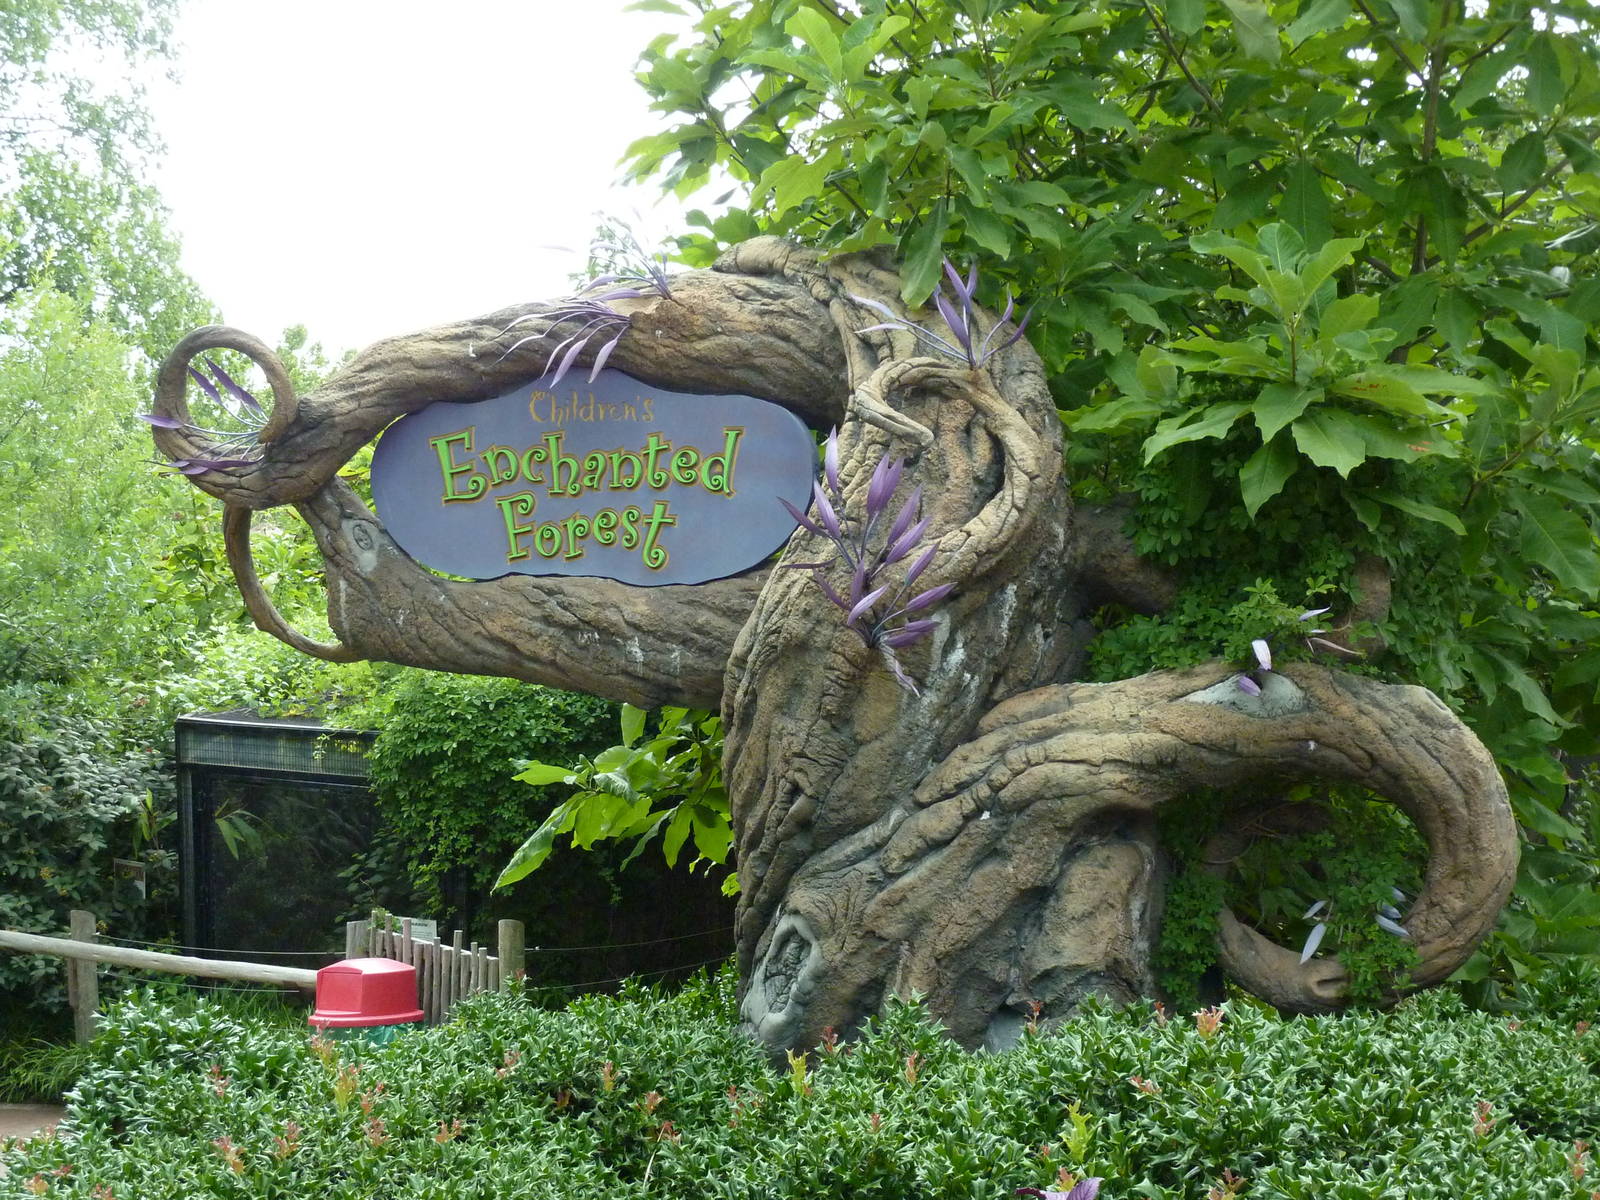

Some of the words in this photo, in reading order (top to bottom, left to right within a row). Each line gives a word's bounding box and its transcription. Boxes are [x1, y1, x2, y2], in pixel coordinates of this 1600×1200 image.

[528, 390, 654, 426] Children's
[430, 427, 744, 504] Enchanted
[497, 491, 677, 570] Forest
